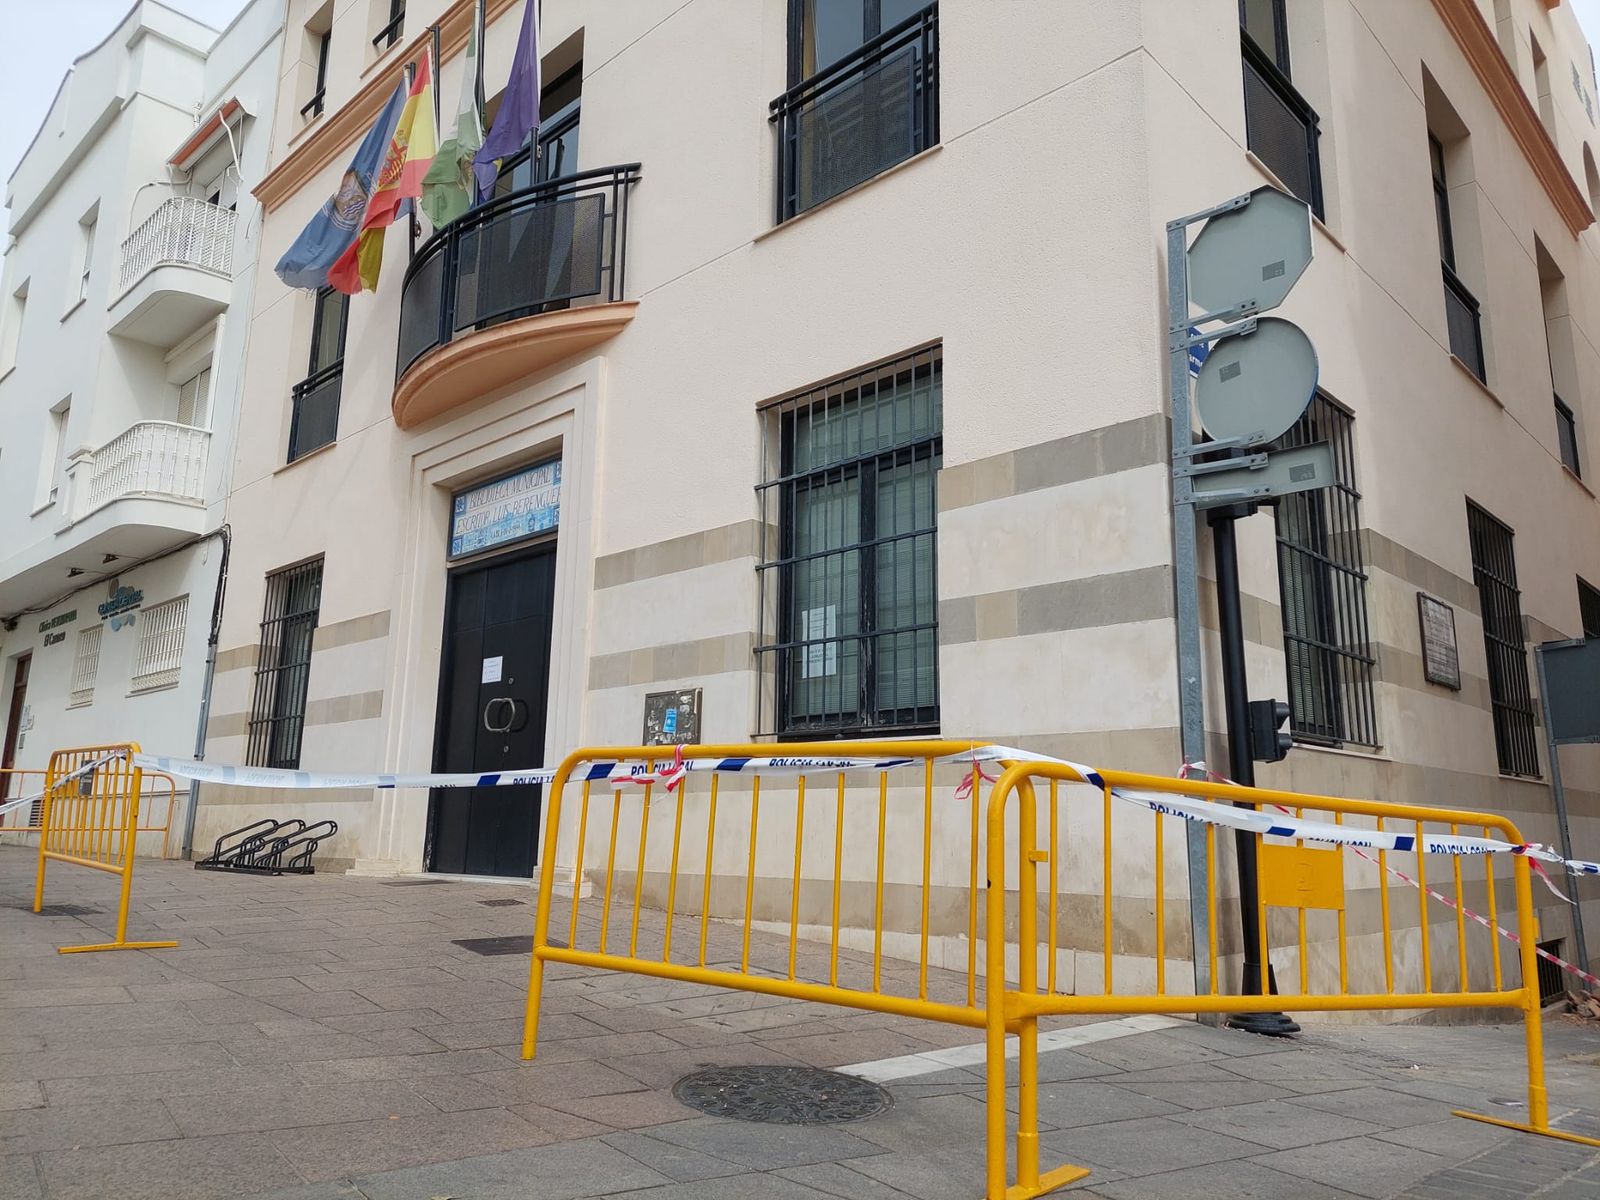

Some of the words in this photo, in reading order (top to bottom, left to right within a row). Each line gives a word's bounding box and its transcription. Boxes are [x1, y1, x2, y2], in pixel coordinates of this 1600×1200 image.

[470, 482, 509, 508] BIBLIOTECA
[512, 467, 551, 492] MUNICIPAL
[456, 510, 490, 534] ESCRITOR
[493, 503, 510, 522] LUIS
[631, 763, 667, 777] POLCIA
